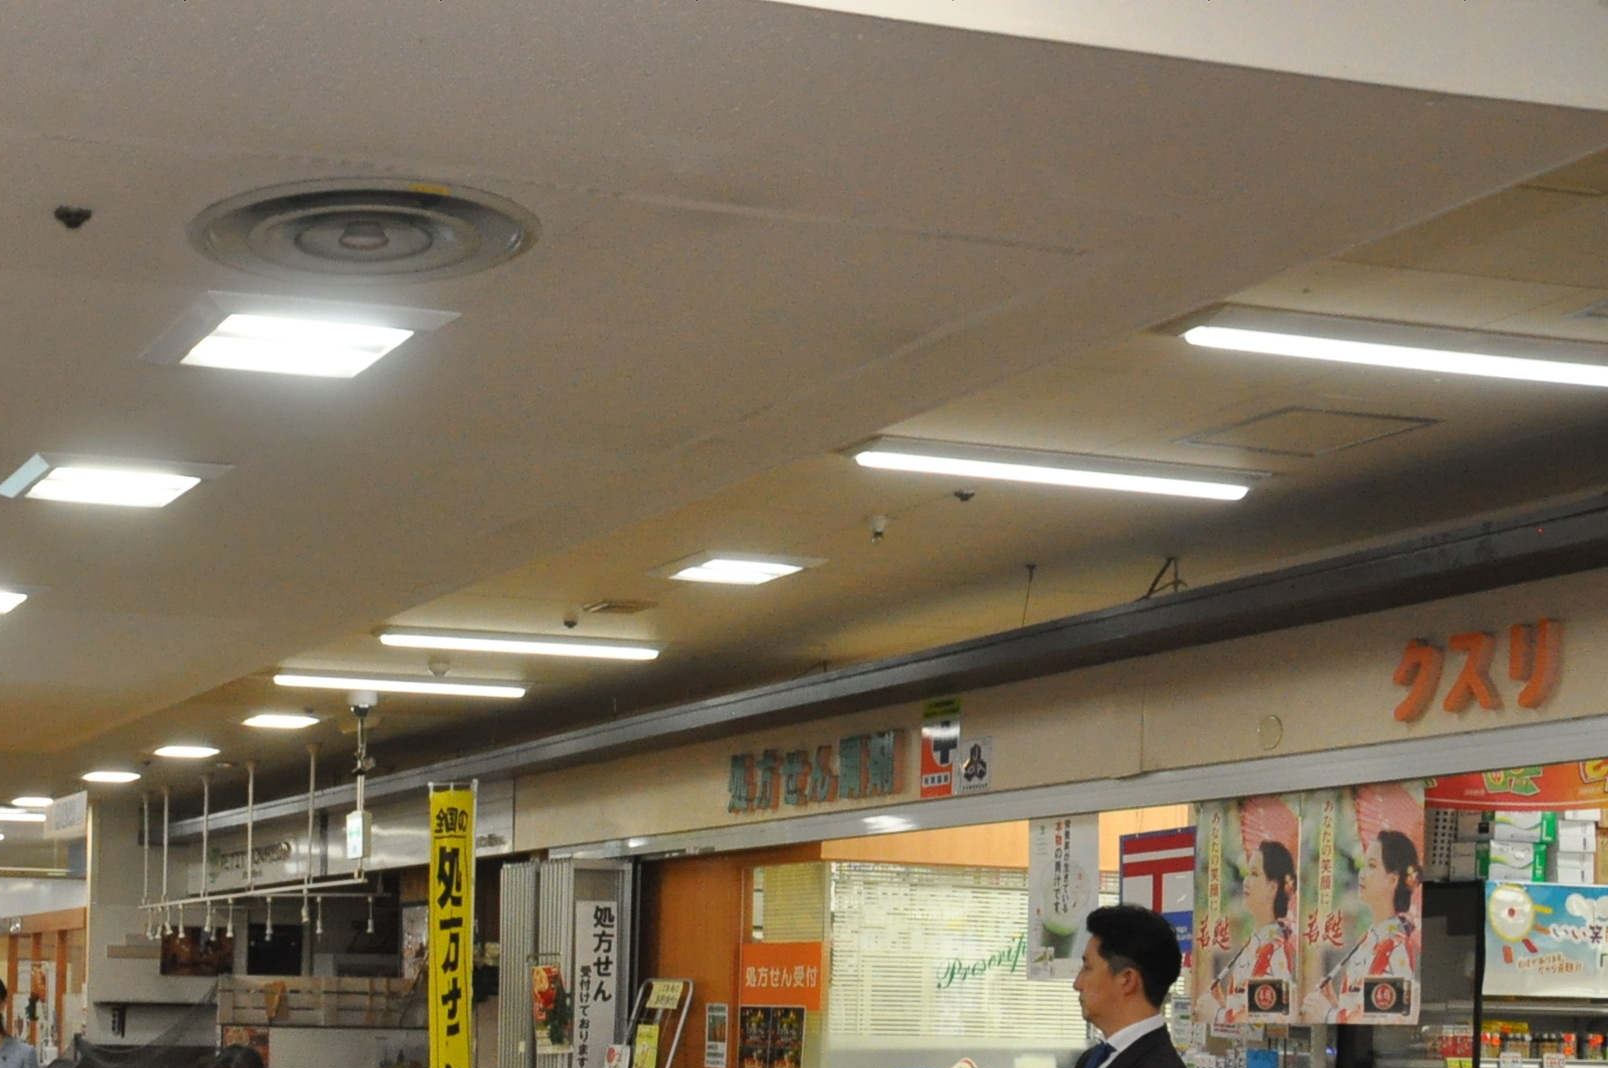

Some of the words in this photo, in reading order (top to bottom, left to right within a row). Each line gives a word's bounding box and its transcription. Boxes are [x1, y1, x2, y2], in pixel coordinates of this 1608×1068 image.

[1392, 618, 1564, 722] クスリ
[435, 808, 468, 834] 全国の
[1210, 811, 1221, 912] あなたの笑顔に
[1321, 800, 1334, 905] あなたの笑顔に
[593, 906, 615, 1002] 処方せん
[745, 965, 818, 988] 処方せん受付
[1552, 924, 1608, 945] いい笑
